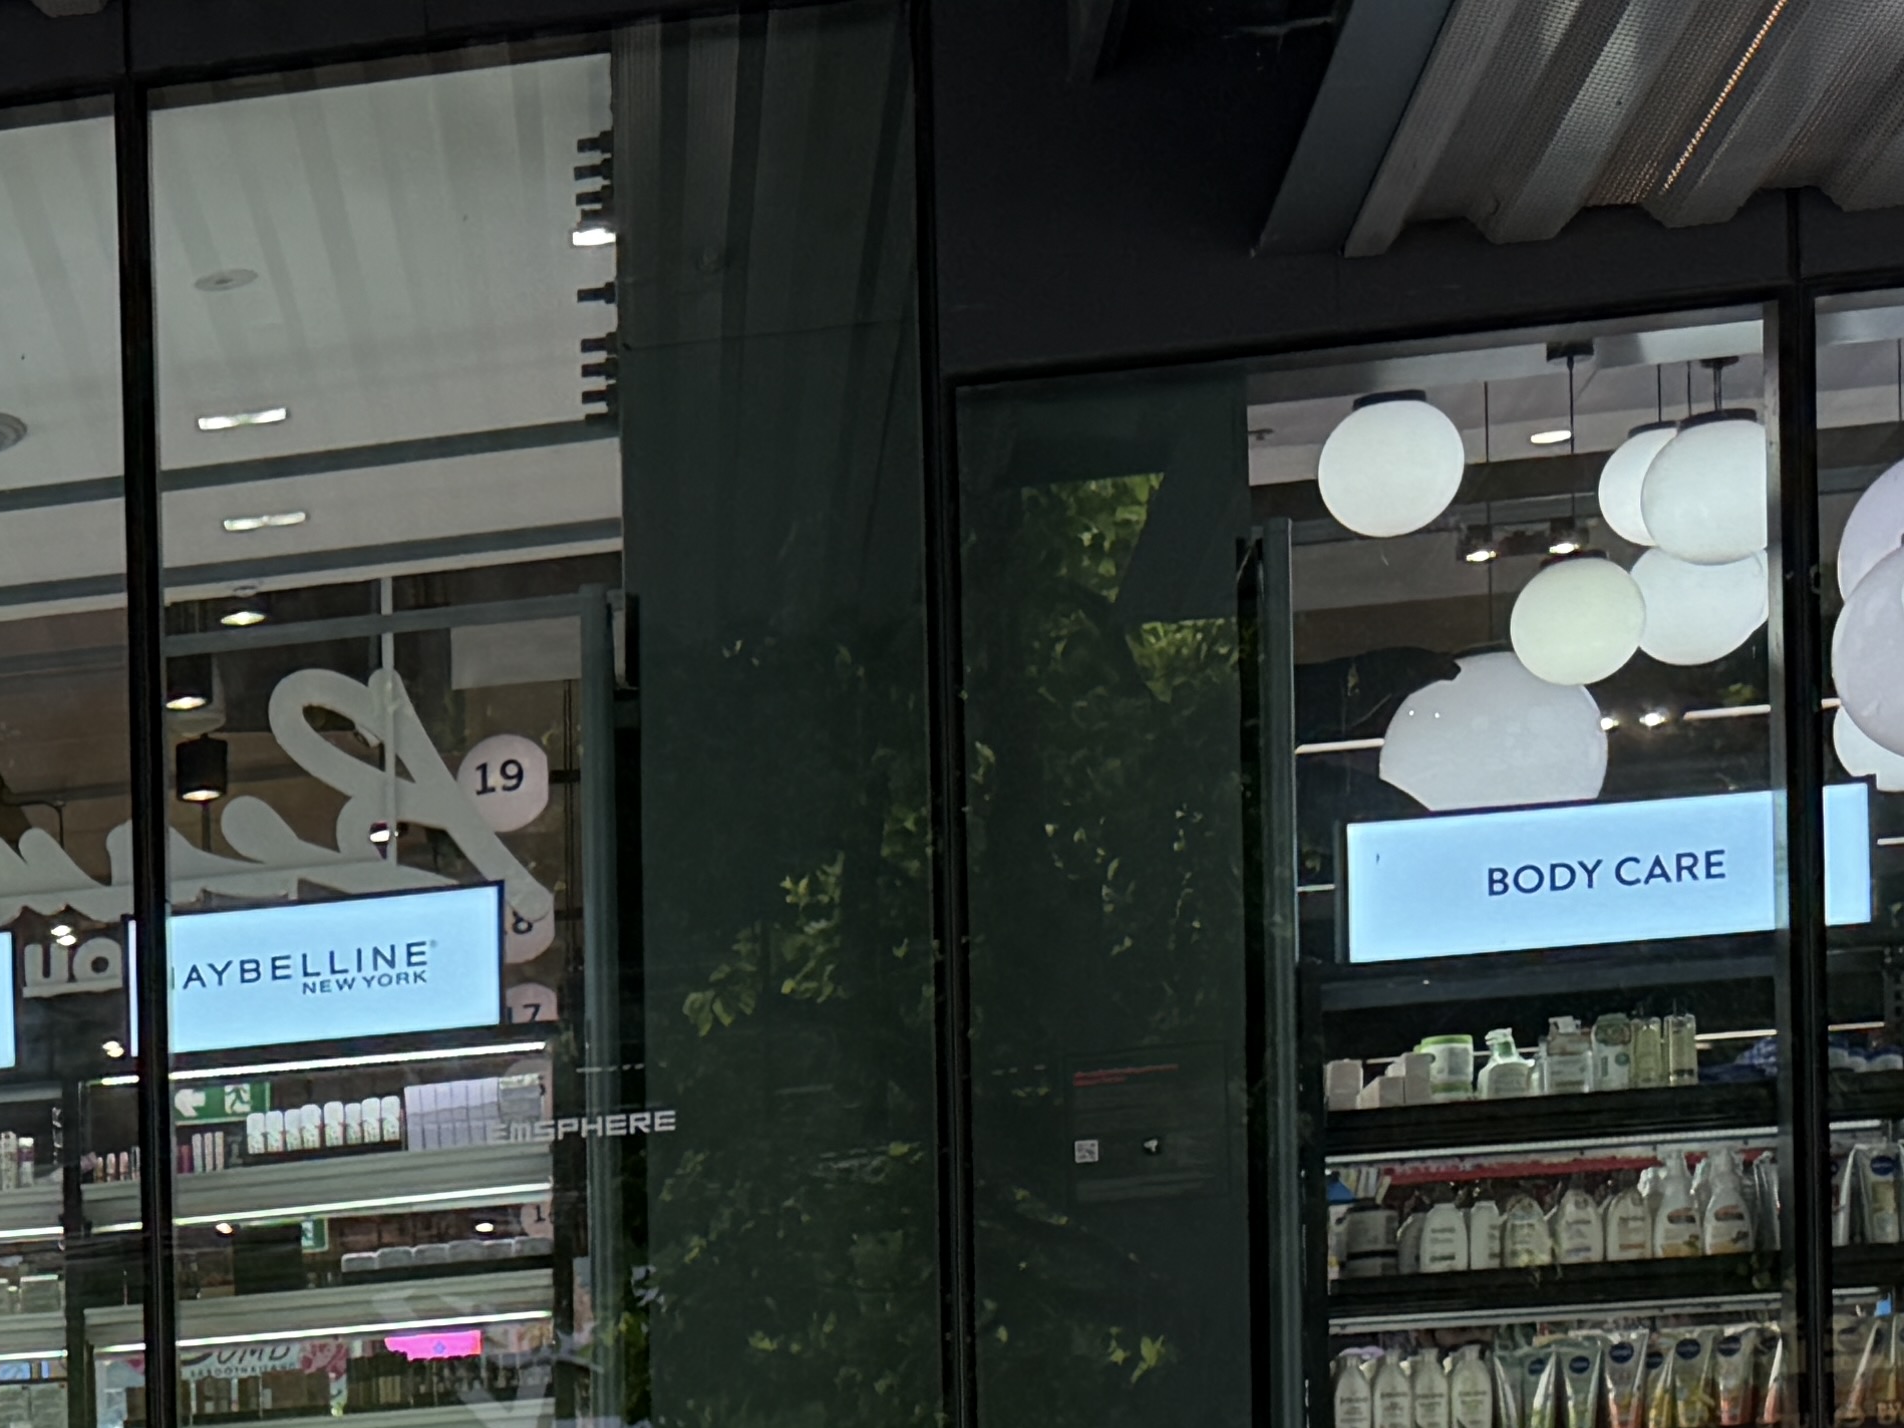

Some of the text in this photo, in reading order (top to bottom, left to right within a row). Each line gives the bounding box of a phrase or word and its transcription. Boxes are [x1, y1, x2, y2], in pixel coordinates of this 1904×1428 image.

[475, 758, 525, 796] 19
[1488, 848, 1726, 897] BODY CARE
[171, 940, 429, 990] AYBELLINE
[301, 968, 428, 996] NEW YORK
[486, 1110, 677, 1145] EMSPHERE
